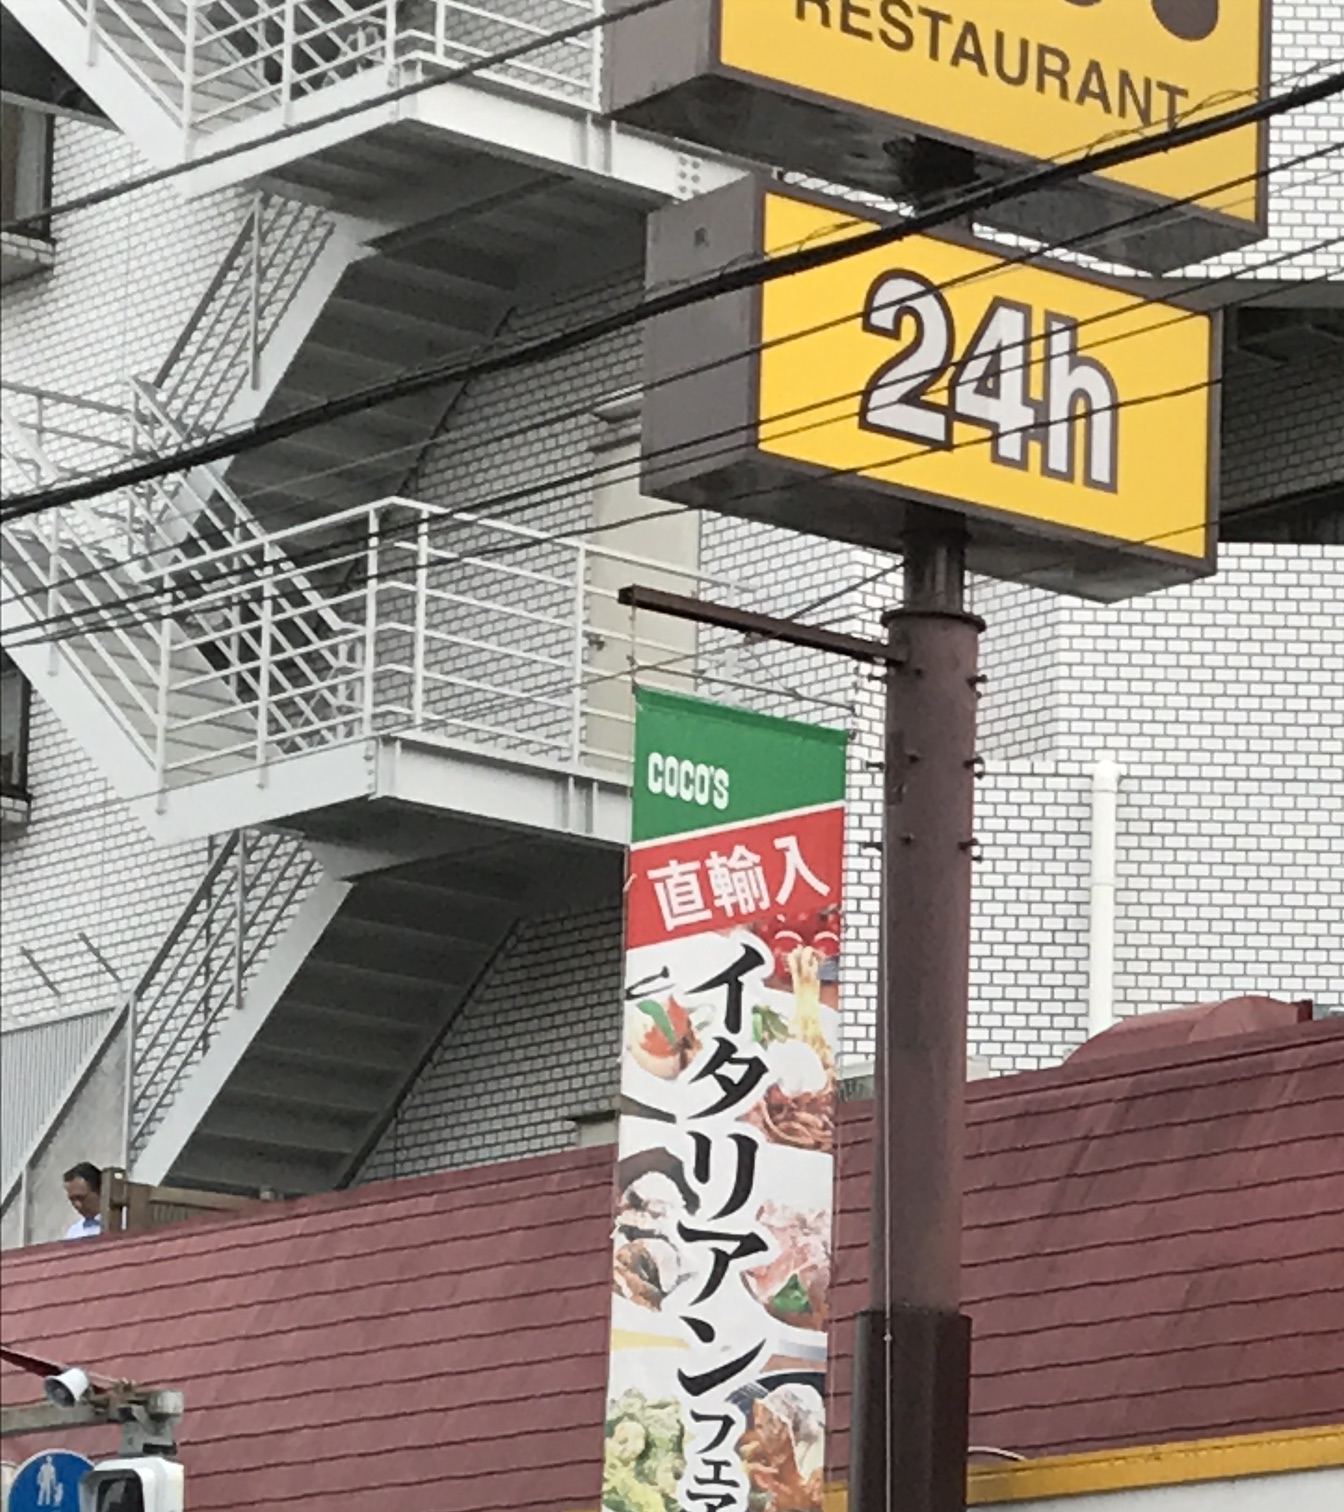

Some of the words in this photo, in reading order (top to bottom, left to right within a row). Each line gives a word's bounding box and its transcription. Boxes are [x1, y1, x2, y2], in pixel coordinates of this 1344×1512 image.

[858, 268, 1118, 495] 24h
[648, 752, 730, 810] COCO'S
[647, 835, 831, 931] 直輸入
